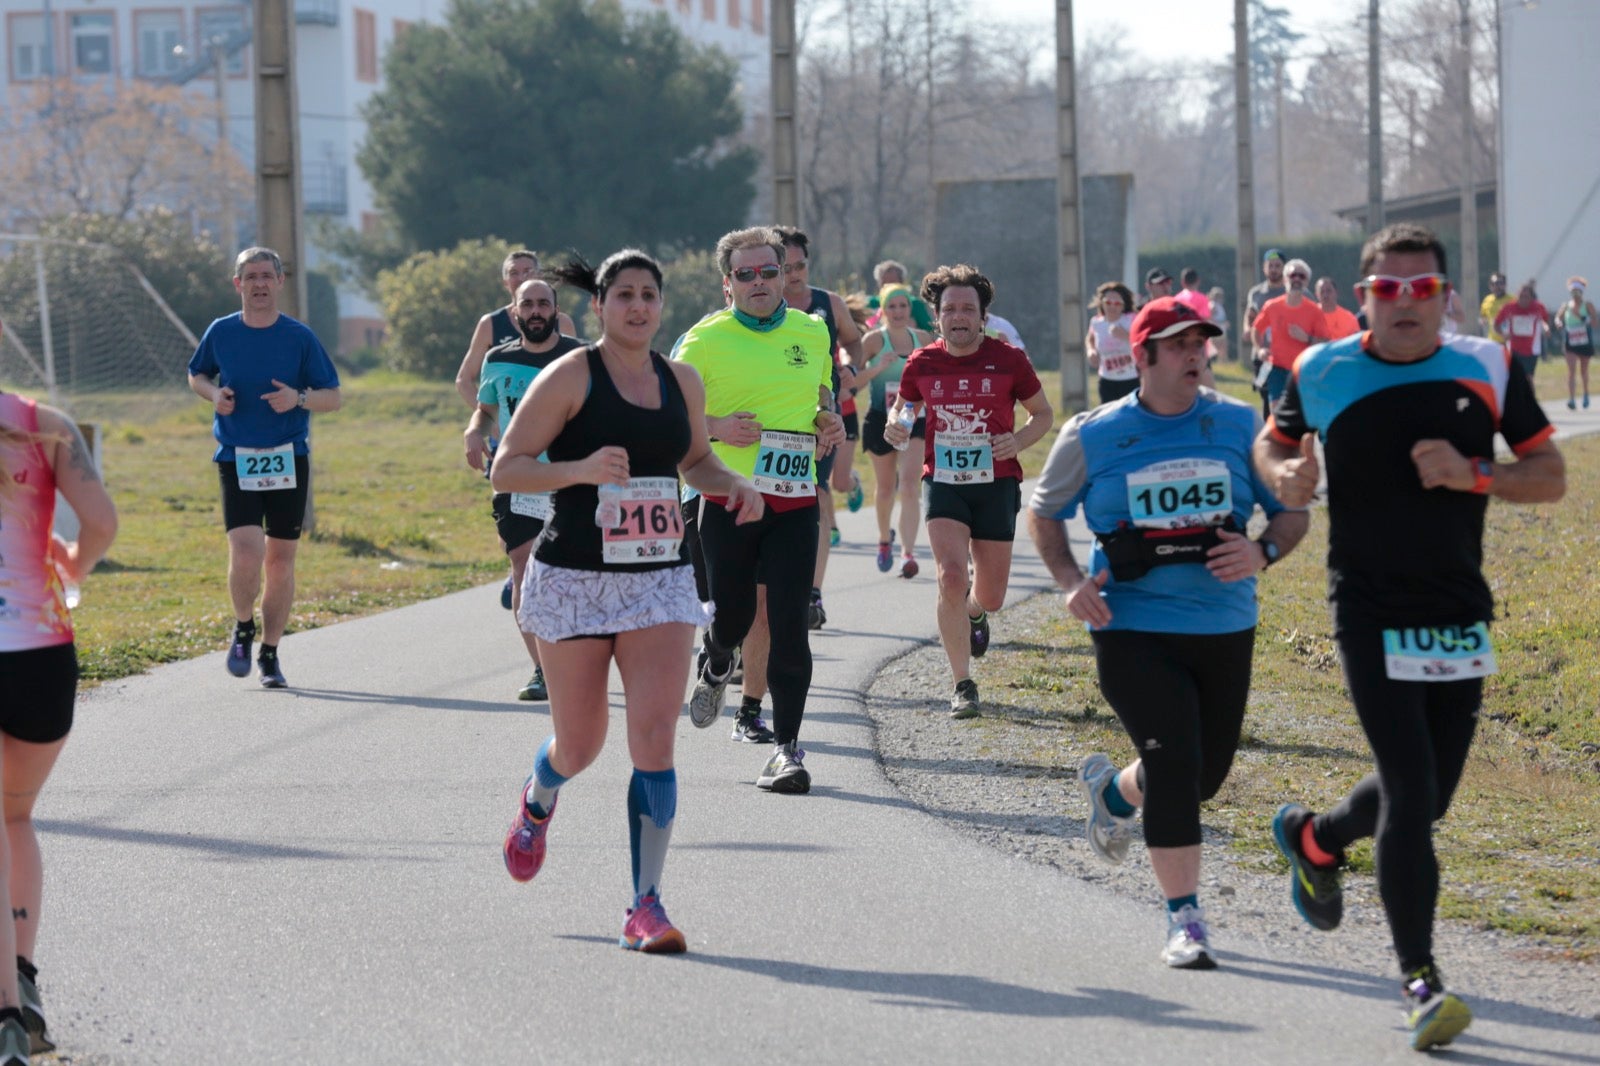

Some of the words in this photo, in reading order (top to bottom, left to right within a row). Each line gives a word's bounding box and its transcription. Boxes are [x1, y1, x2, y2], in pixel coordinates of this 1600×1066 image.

[246, 455, 285, 475] 223
[761, 451, 810, 477] 1099
[944, 449, 982, 469] 157
[1136, 481, 1225, 516] 1045
